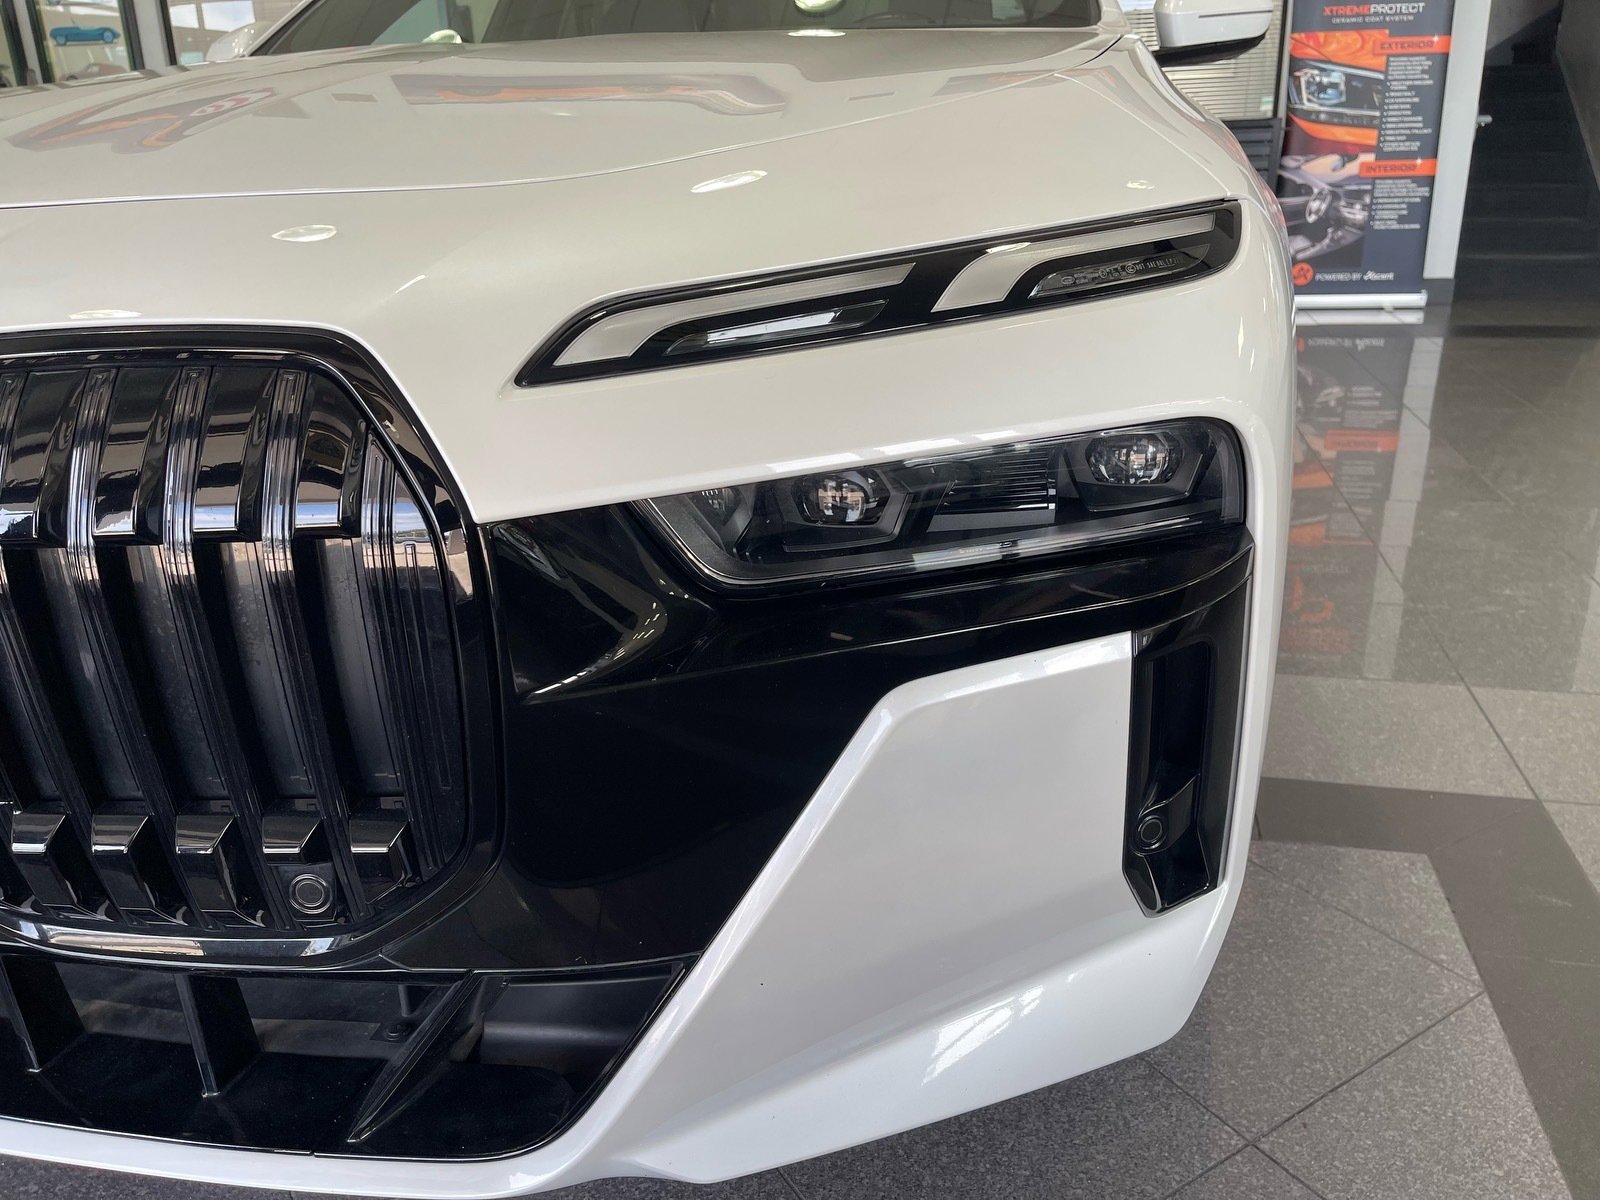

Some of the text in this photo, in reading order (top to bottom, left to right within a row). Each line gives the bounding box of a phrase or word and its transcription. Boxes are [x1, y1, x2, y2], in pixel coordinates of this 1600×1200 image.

[1323, 2, 1425, 16] XTREMEPROTECT
[1380, 40, 1434, 50] EXTERIOR
[1366, 163, 1417, 173] INTERIOR
[1315, 272, 1351, 281] POWERED
[1352, 272, 1362, 281] BY
